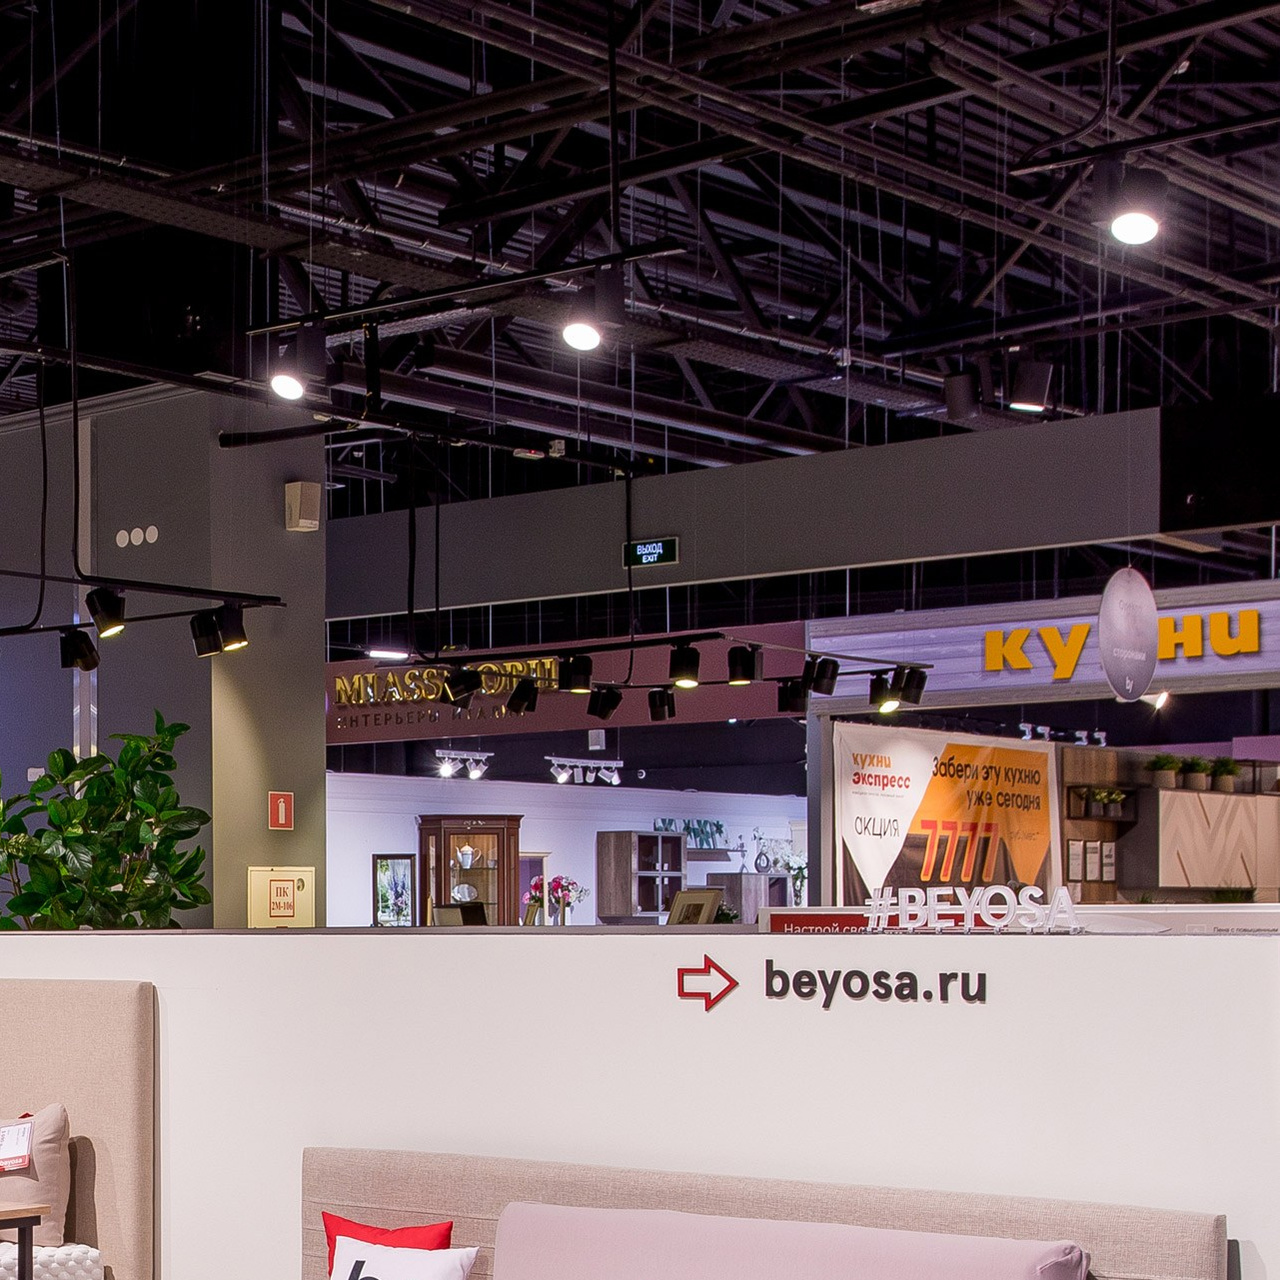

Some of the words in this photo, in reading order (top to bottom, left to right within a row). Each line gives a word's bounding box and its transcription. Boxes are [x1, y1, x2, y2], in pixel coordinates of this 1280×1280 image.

[636, 543, 663, 555] ВЫХОД
[642, 554, 658, 563] EXIT
[984, 609, 1261, 681] куни
[852, 753, 892, 770] кухни
[932, 756, 979, 782] Забери
[981, 765, 1001, 786] эту
[1004, 766, 1041, 787] кухню
[852, 771, 911, 791] экспресс
[966, 789, 993, 810] уже
[996, 792, 1041, 811] сегодня
[920, 819, 999, 882] 7777
[276, 886, 289, 897] ПК
[864, 885, 1080, 929] #BEYOSA
[765, 959, 988, 1010] beyosa.ru
